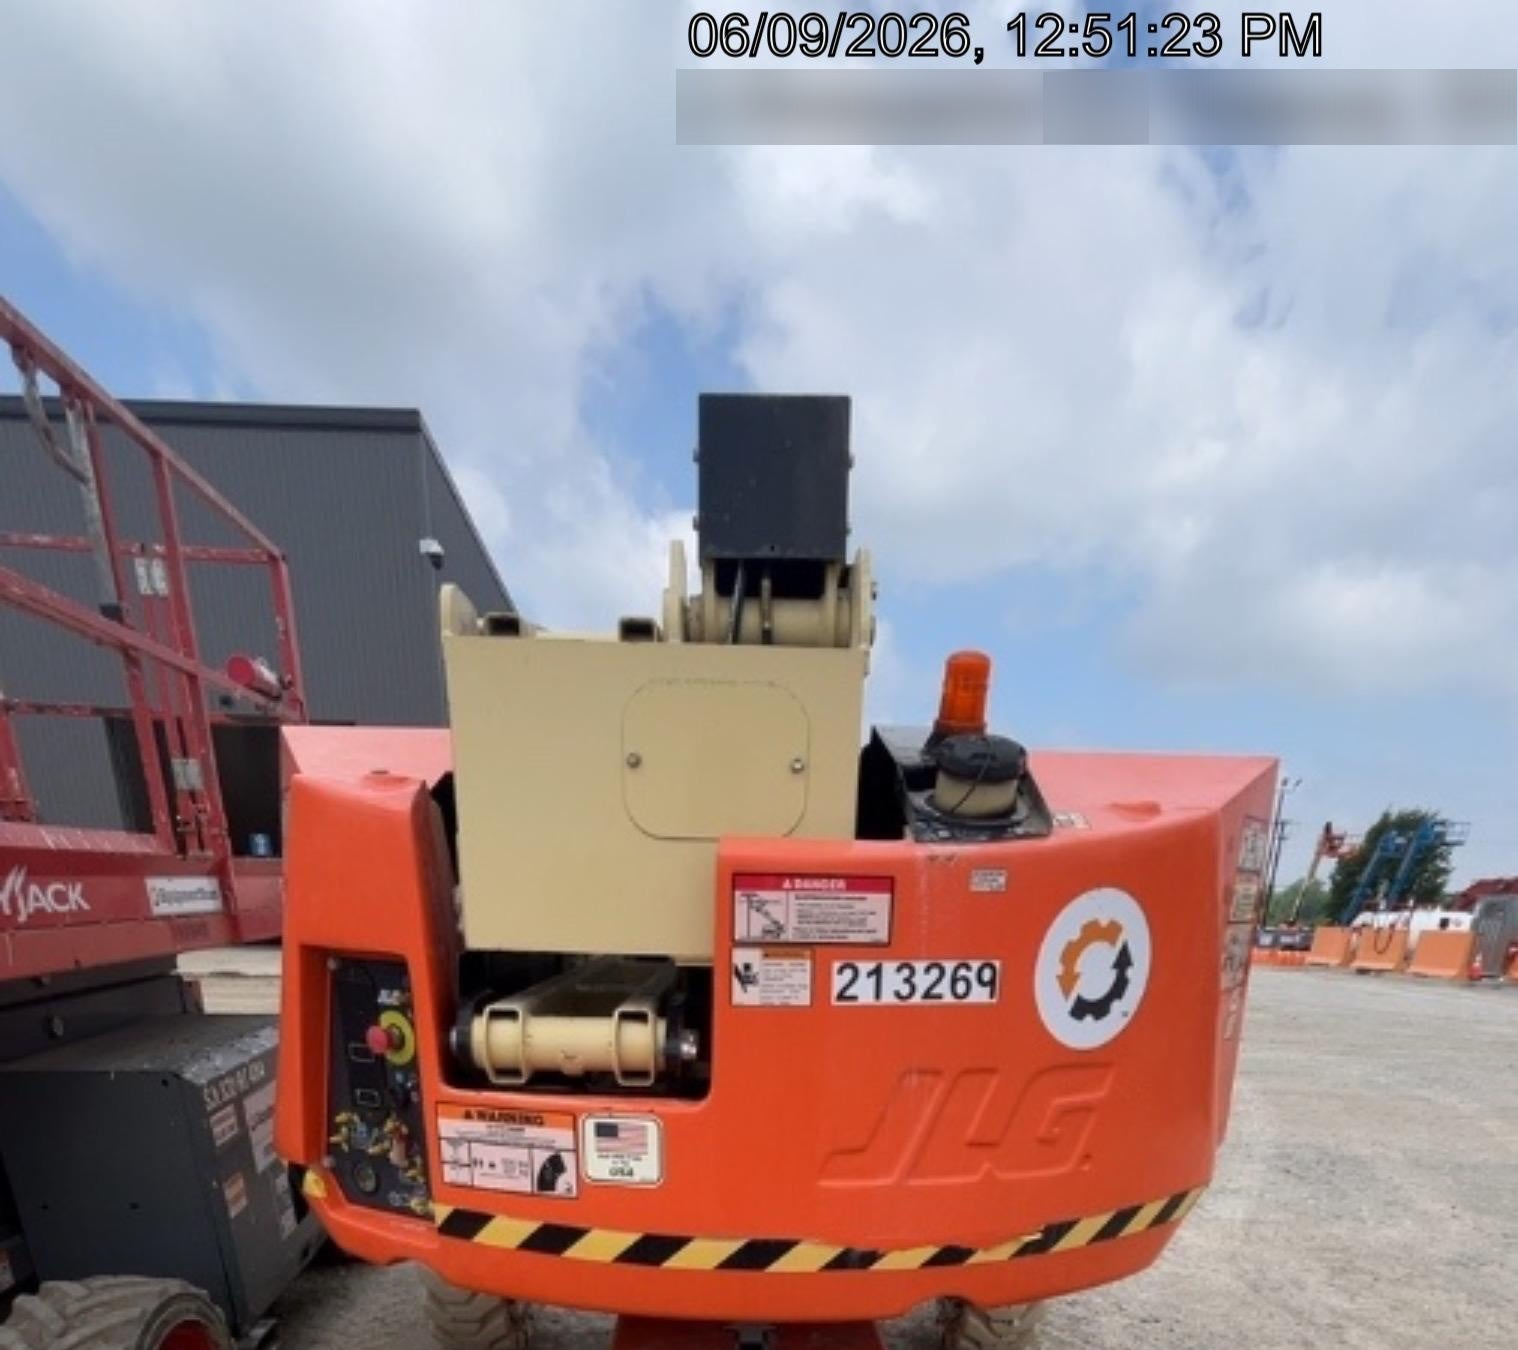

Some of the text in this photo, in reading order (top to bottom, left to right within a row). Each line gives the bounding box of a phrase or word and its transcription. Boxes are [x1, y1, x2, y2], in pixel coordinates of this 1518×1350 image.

[794, 878, 847, 890] DANGER
[836, 962, 997, 1000] 213269
[477, 1109, 545, 1126] WARNING
[816, 1061, 1114, 1187] JLG
